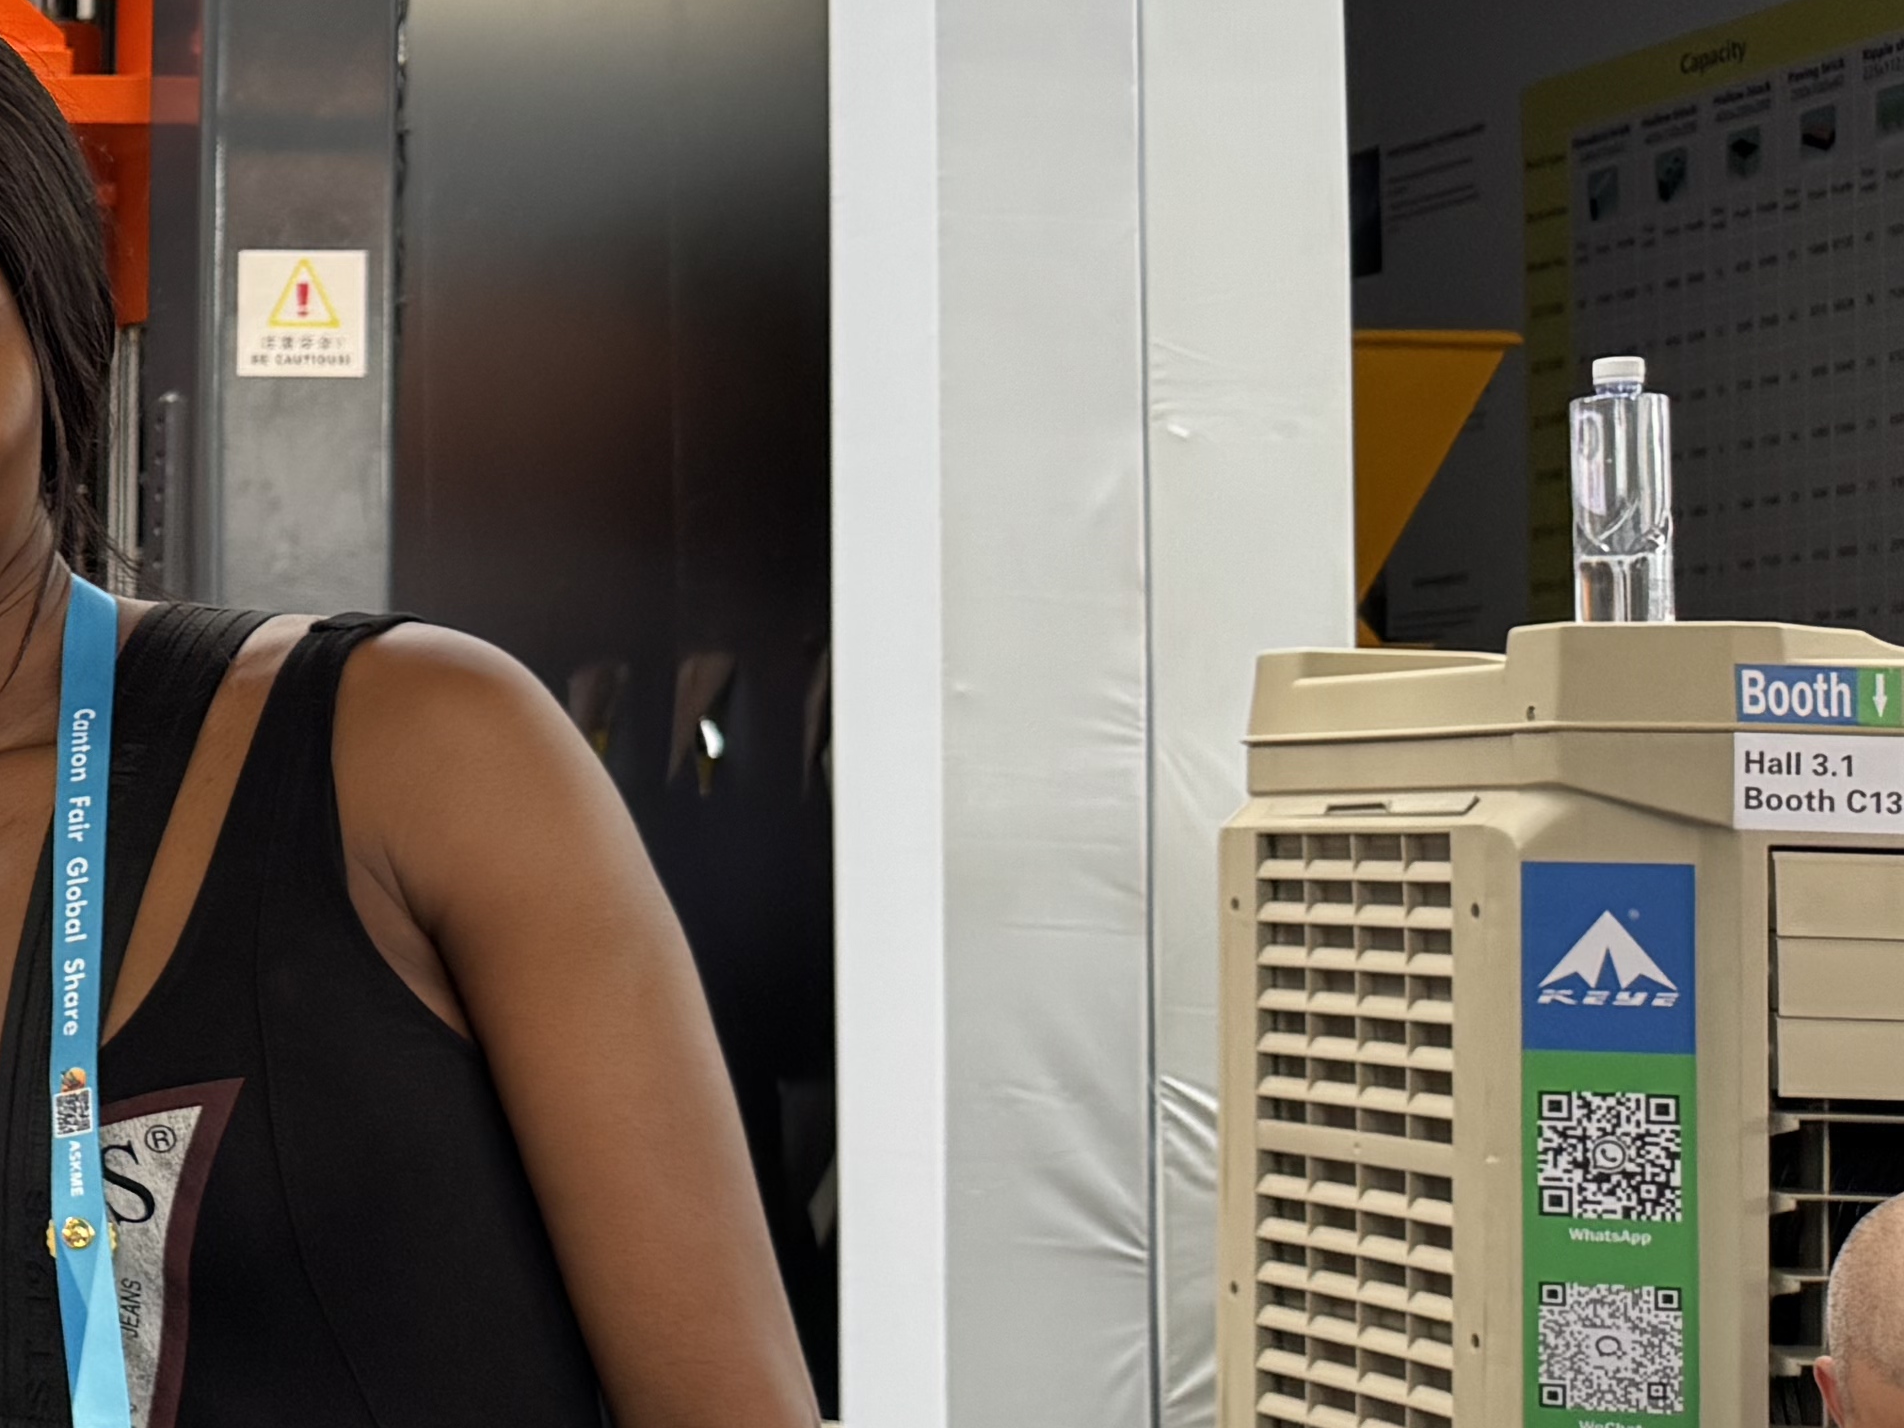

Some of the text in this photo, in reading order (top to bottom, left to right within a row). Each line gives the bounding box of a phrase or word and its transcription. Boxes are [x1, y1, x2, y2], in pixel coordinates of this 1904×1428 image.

[1680, 40, 1747, 74] Capacity
[1742, 669, 1852, 717] Booth
[1745, 750, 1853, 777] Hall 3.1
[1744, 786, 1903, 814] Booth C13
[62, 708, 96, 1036] Canton Fair Global Share
[68, 1140, 84, 1197] ASKME
[1569, 1226, 1652, 1246] WhatsApp
